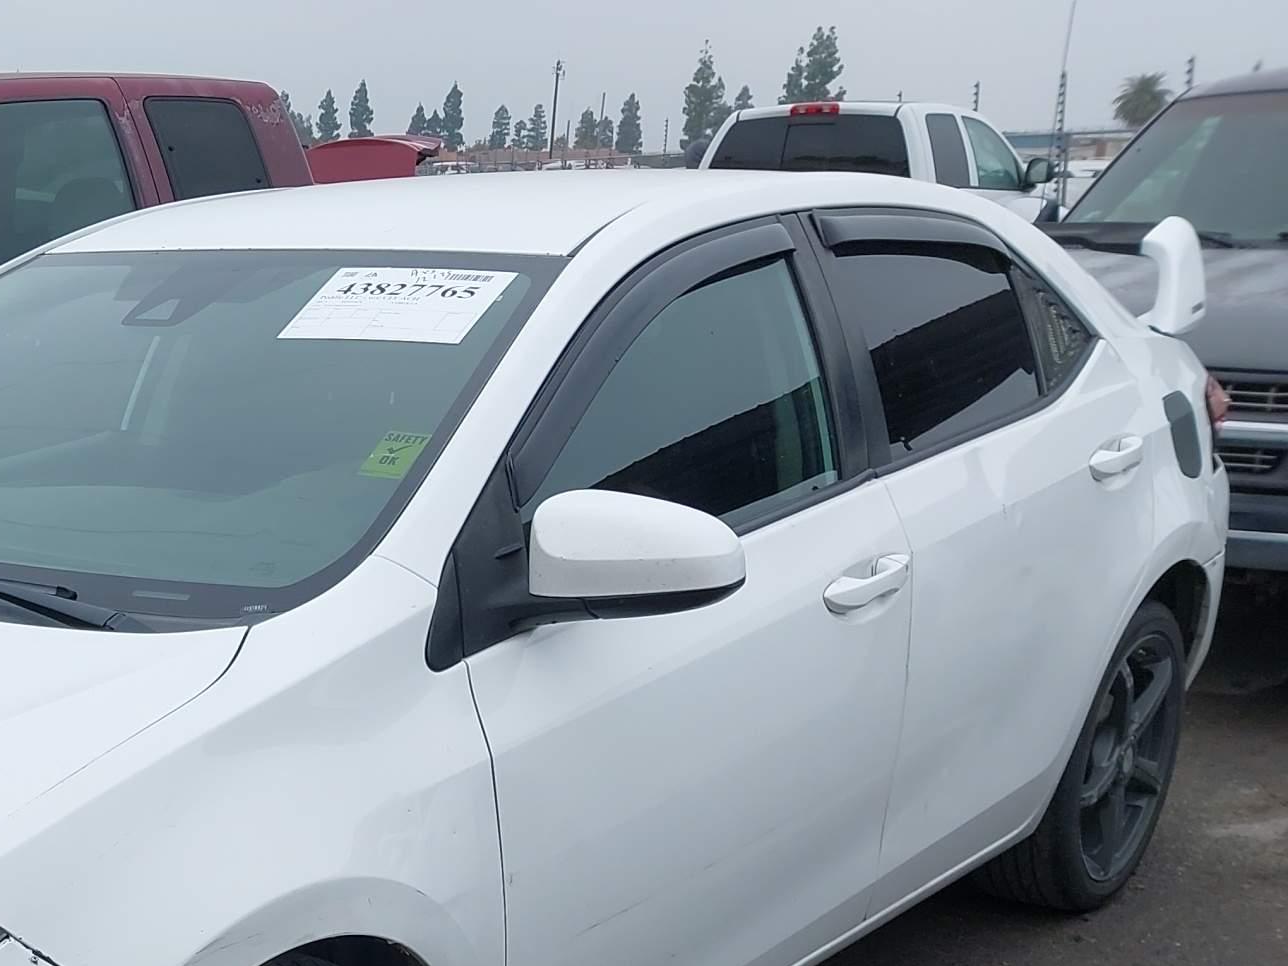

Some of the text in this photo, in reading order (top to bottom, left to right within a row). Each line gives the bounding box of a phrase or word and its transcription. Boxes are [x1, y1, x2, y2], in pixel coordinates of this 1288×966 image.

[336, 282, 481, 299] 43827765
[384, 432, 429, 446] SAFETY
[378, 455, 400, 466] OK
